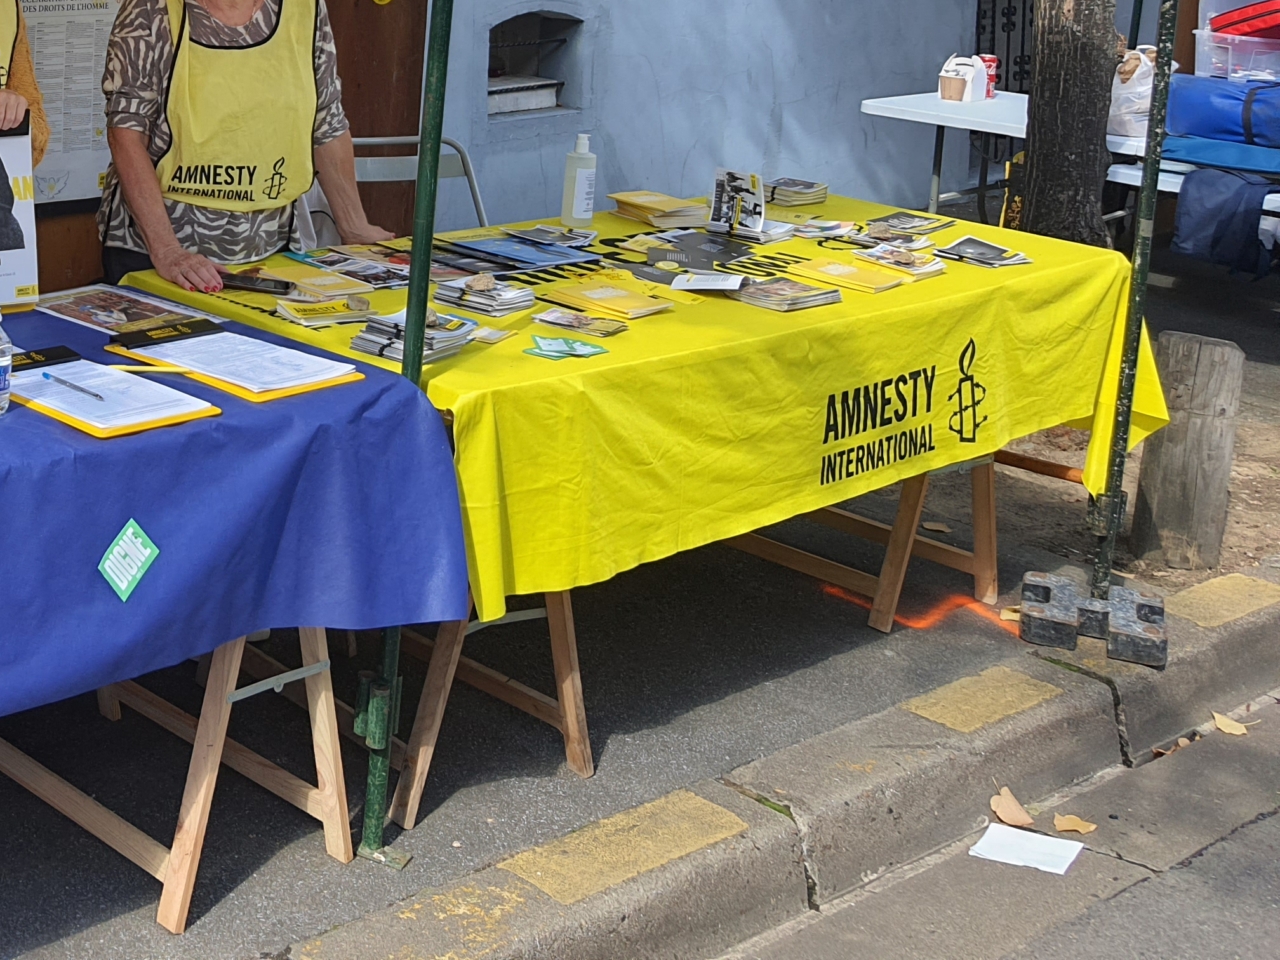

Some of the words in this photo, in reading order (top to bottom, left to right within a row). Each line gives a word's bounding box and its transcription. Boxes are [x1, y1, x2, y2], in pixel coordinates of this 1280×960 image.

[23, 5, 37, 13] DES
[38, 4, 65, 13] DROITS
[66, 3, 76, 12] DE
[77, 2, 110, 12] L'HOMME
[11, 175, 34, 201] AN
[170, 164, 258, 186] AMNESTY
[167, 184, 256, 202] INTERNATIONAL
[822, 364, 936, 445] AMNESTY
[820, 423, 936, 486] INTERNATIONAL
[104, 526, 151, 591] DIGNE
